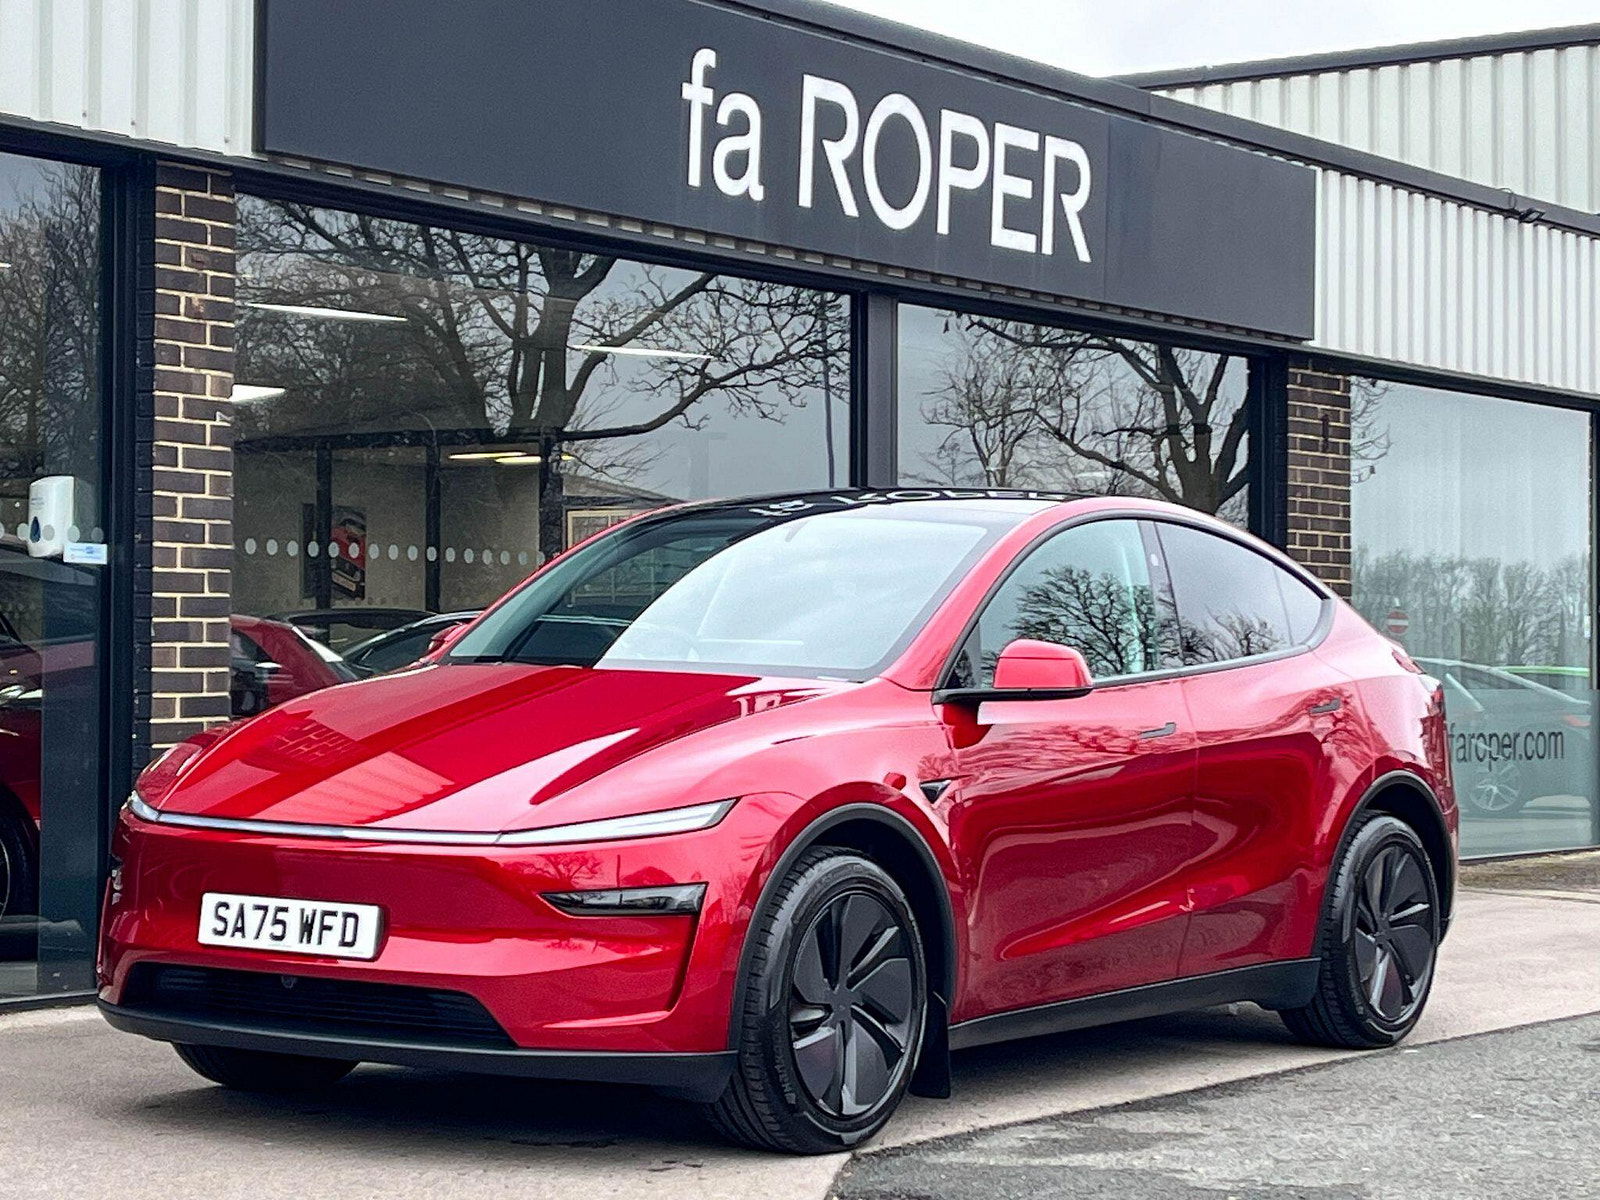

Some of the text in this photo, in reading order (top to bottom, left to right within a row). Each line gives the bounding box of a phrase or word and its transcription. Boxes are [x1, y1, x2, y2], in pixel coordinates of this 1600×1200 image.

[681, 47, 1092, 263] fa ROPER
[211, 900, 360, 948] SA75 WFD
